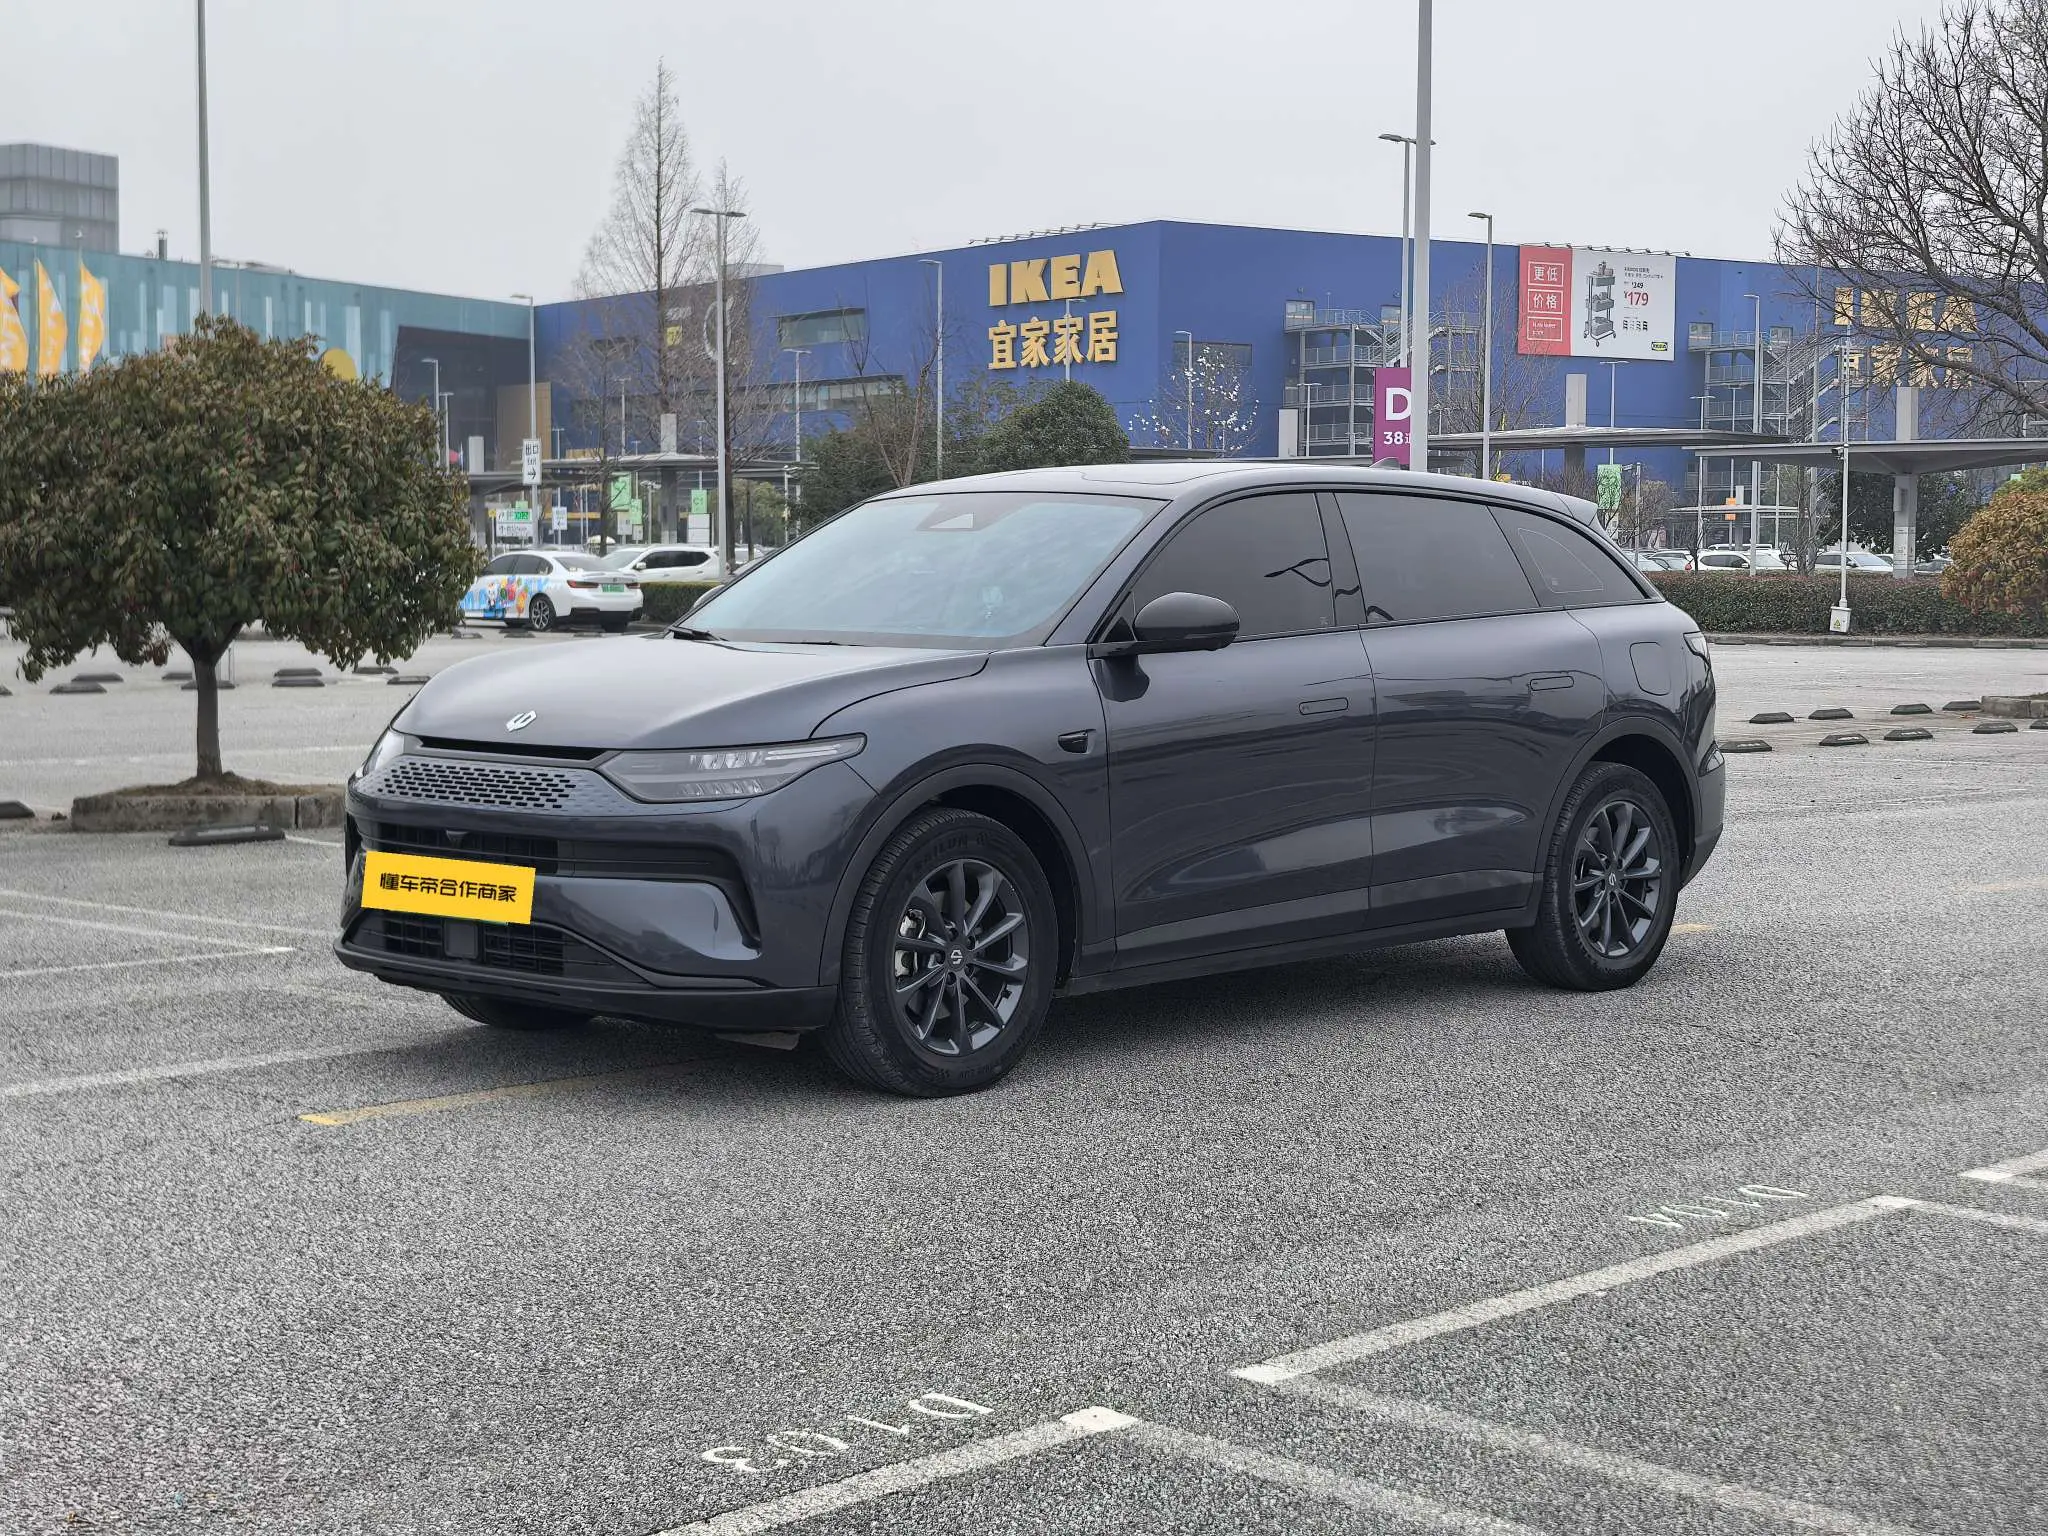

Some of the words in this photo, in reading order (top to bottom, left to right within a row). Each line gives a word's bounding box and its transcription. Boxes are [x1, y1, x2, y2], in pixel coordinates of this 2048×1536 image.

[989, 249, 1124, 306] IKEA
[1534, 266, 1558, 281] 更低
[1533, 293, 1557, 309] 价格
[1834, 286, 1978, 333] IKEA
[988, 310, 1119, 370] 宜家家居
[1386, 388, 1411, 420] D
[701, 1392, 994, 1472] D103
